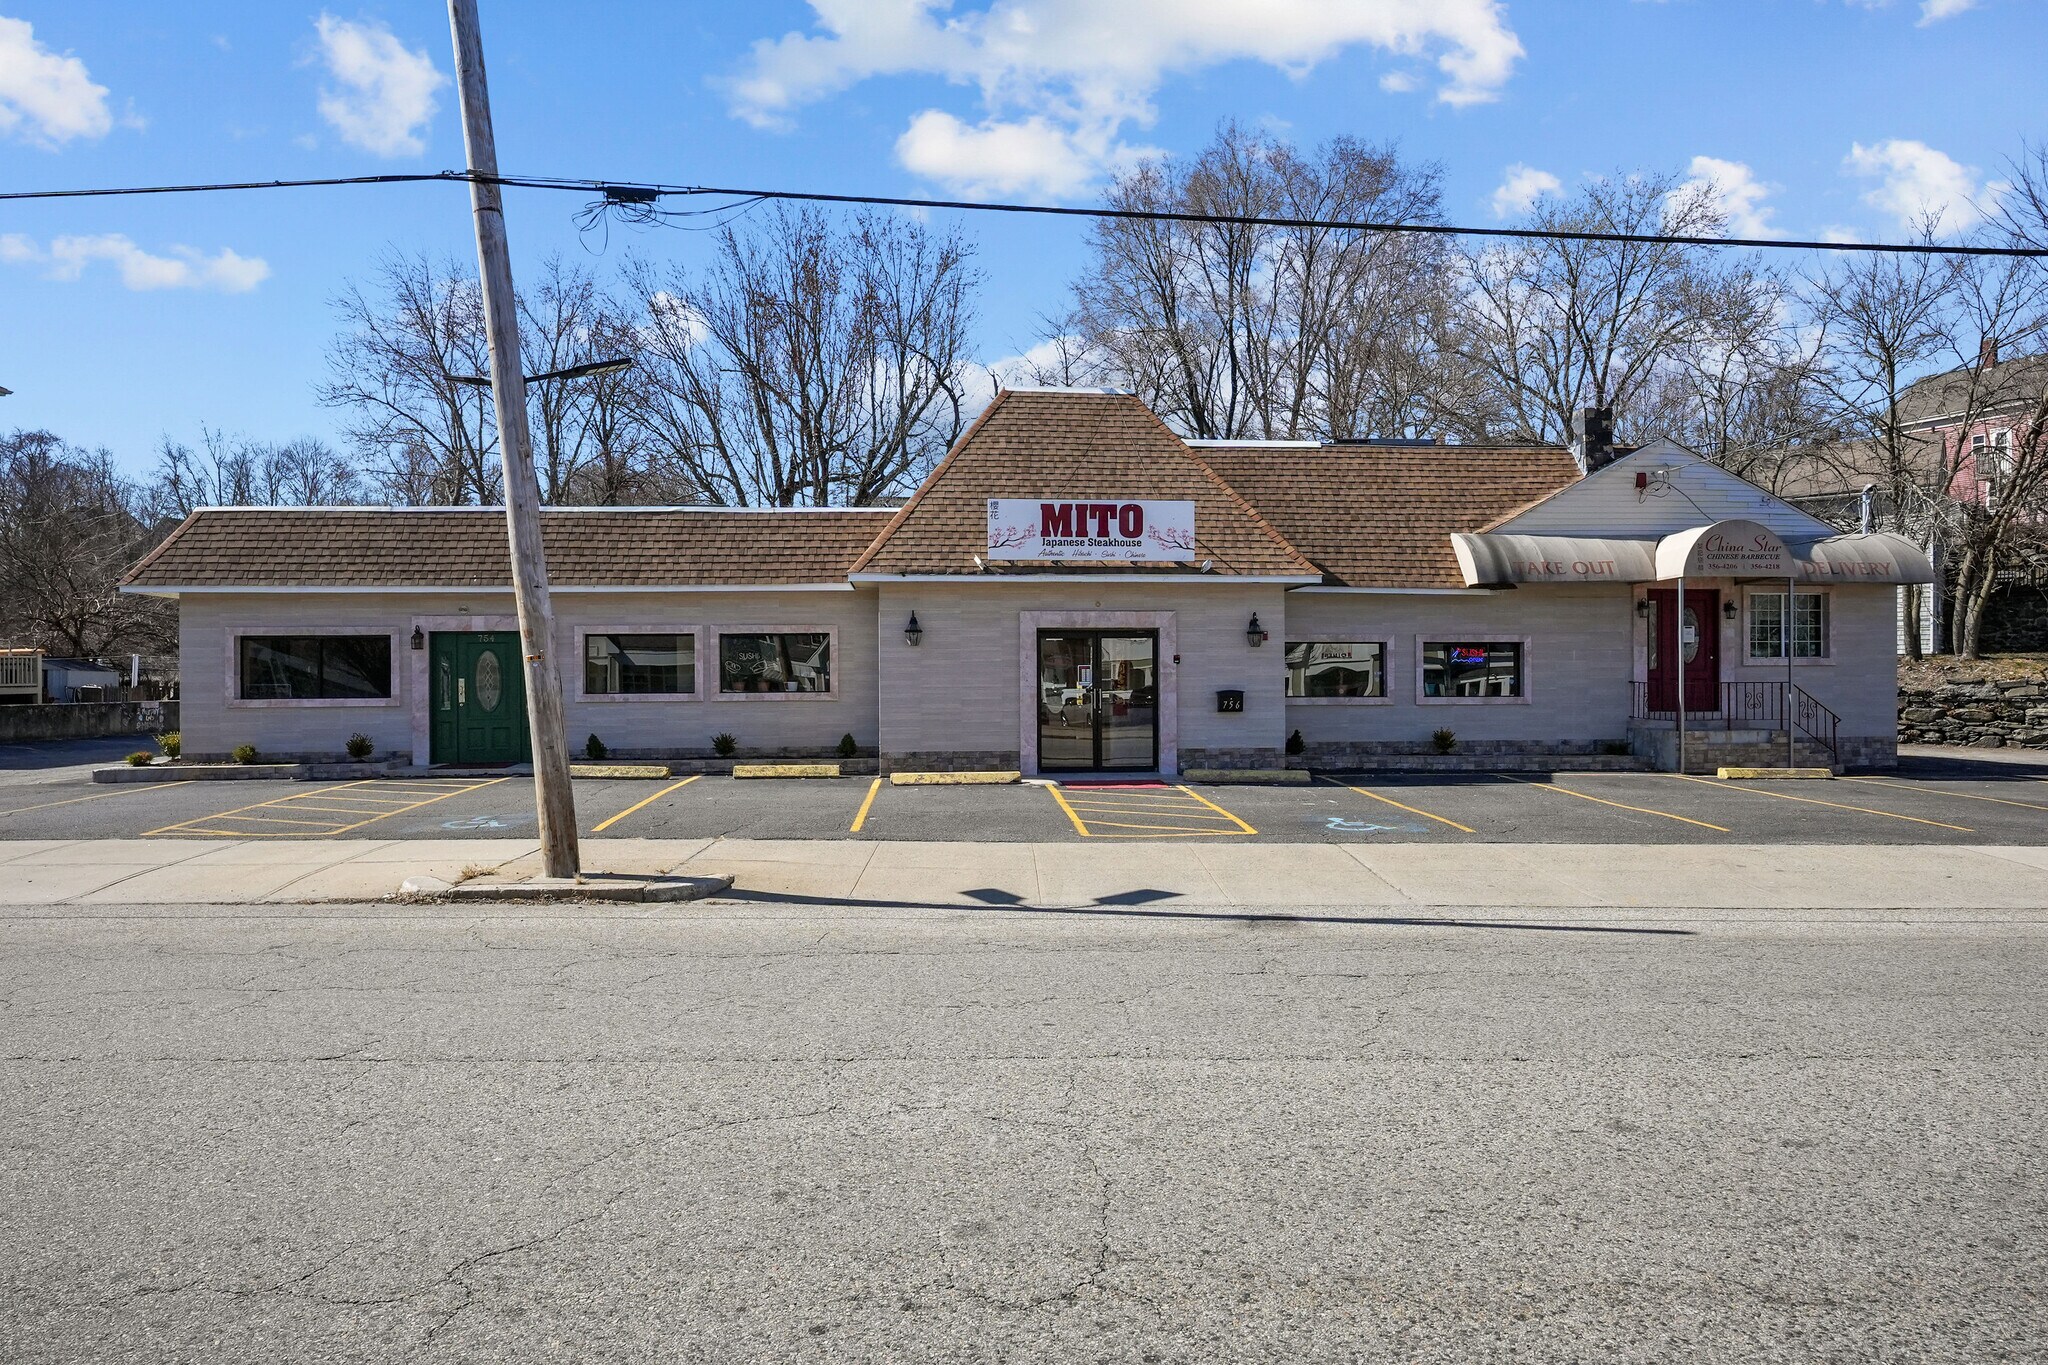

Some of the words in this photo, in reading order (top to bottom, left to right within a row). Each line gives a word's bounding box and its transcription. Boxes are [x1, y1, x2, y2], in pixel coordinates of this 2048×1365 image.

[1040, 503, 1144, 538] MITO
[1042, 538, 1085, 548] Japanese
[1087, 538, 1142, 547] Steakhouse
[1705, 533, 1744, 552] China
[1748, 533, 1782, 552] Star
[1037, 548, 1065, 557] Authentic
[1071, 549, 1093, 557] Hibachi
[1101, 550, 1116, 558] Sushi
[1124, 550, 1146, 558] Chinese
[1512, 560, 1567, 575] TAKE
[1571, 560, 1614, 575] OUT
[1802, 561, 1891, 576] DELIVERY
[477, 634, 495, 643] 754
[1222, 700, 1240, 710] 756
